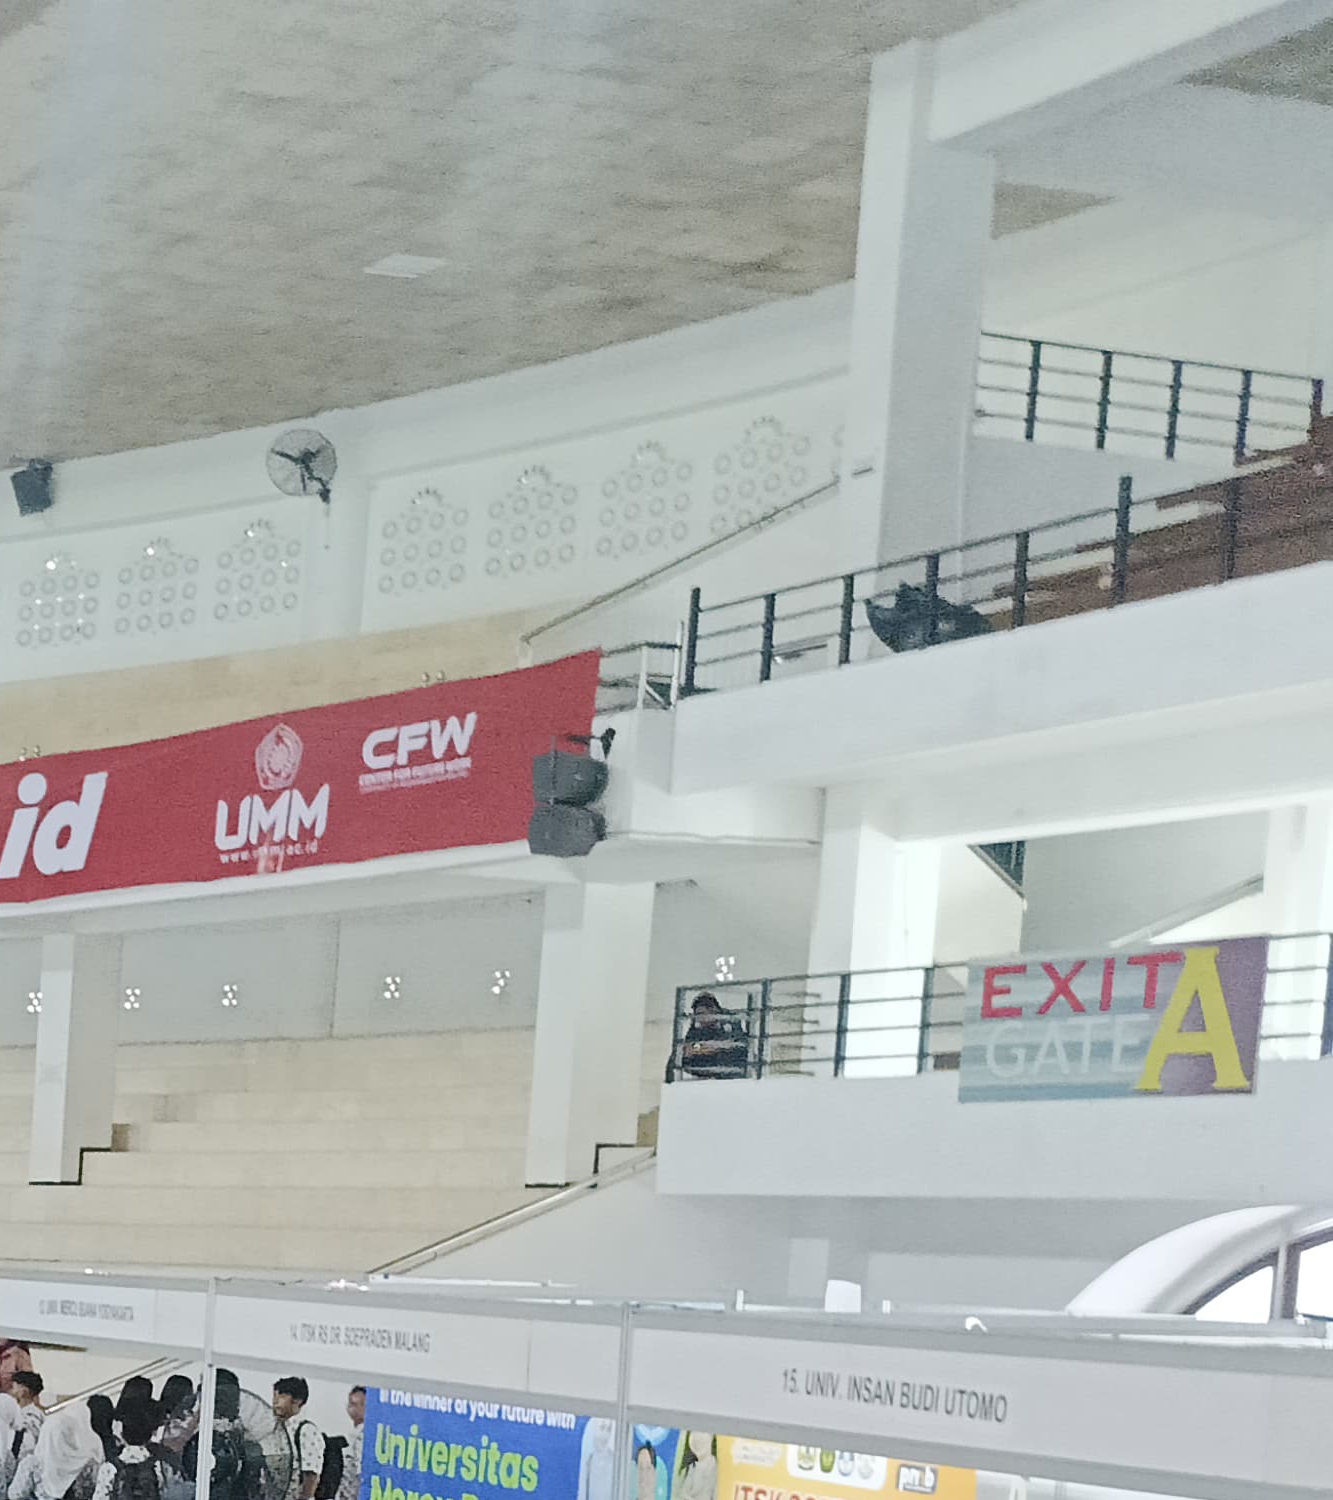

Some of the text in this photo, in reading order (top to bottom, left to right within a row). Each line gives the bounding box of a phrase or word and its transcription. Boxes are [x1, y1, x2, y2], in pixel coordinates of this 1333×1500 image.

[362, 711, 477, 769] CFW
[215, 783, 330, 851] UMM
[981, 950, 1184, 1018] EXIT
[985, 1013, 1152, 1077] GATE
[1135, 946, 1251, 1090] A
[394, 1330, 431, 1354] MALANG
[469, 1400, 500, 1422] your
[782, 1368, 1008, 1424] 15. UNIV. INSAN BUDI UTOMO
[375, 1422, 539, 1492] Universitas
